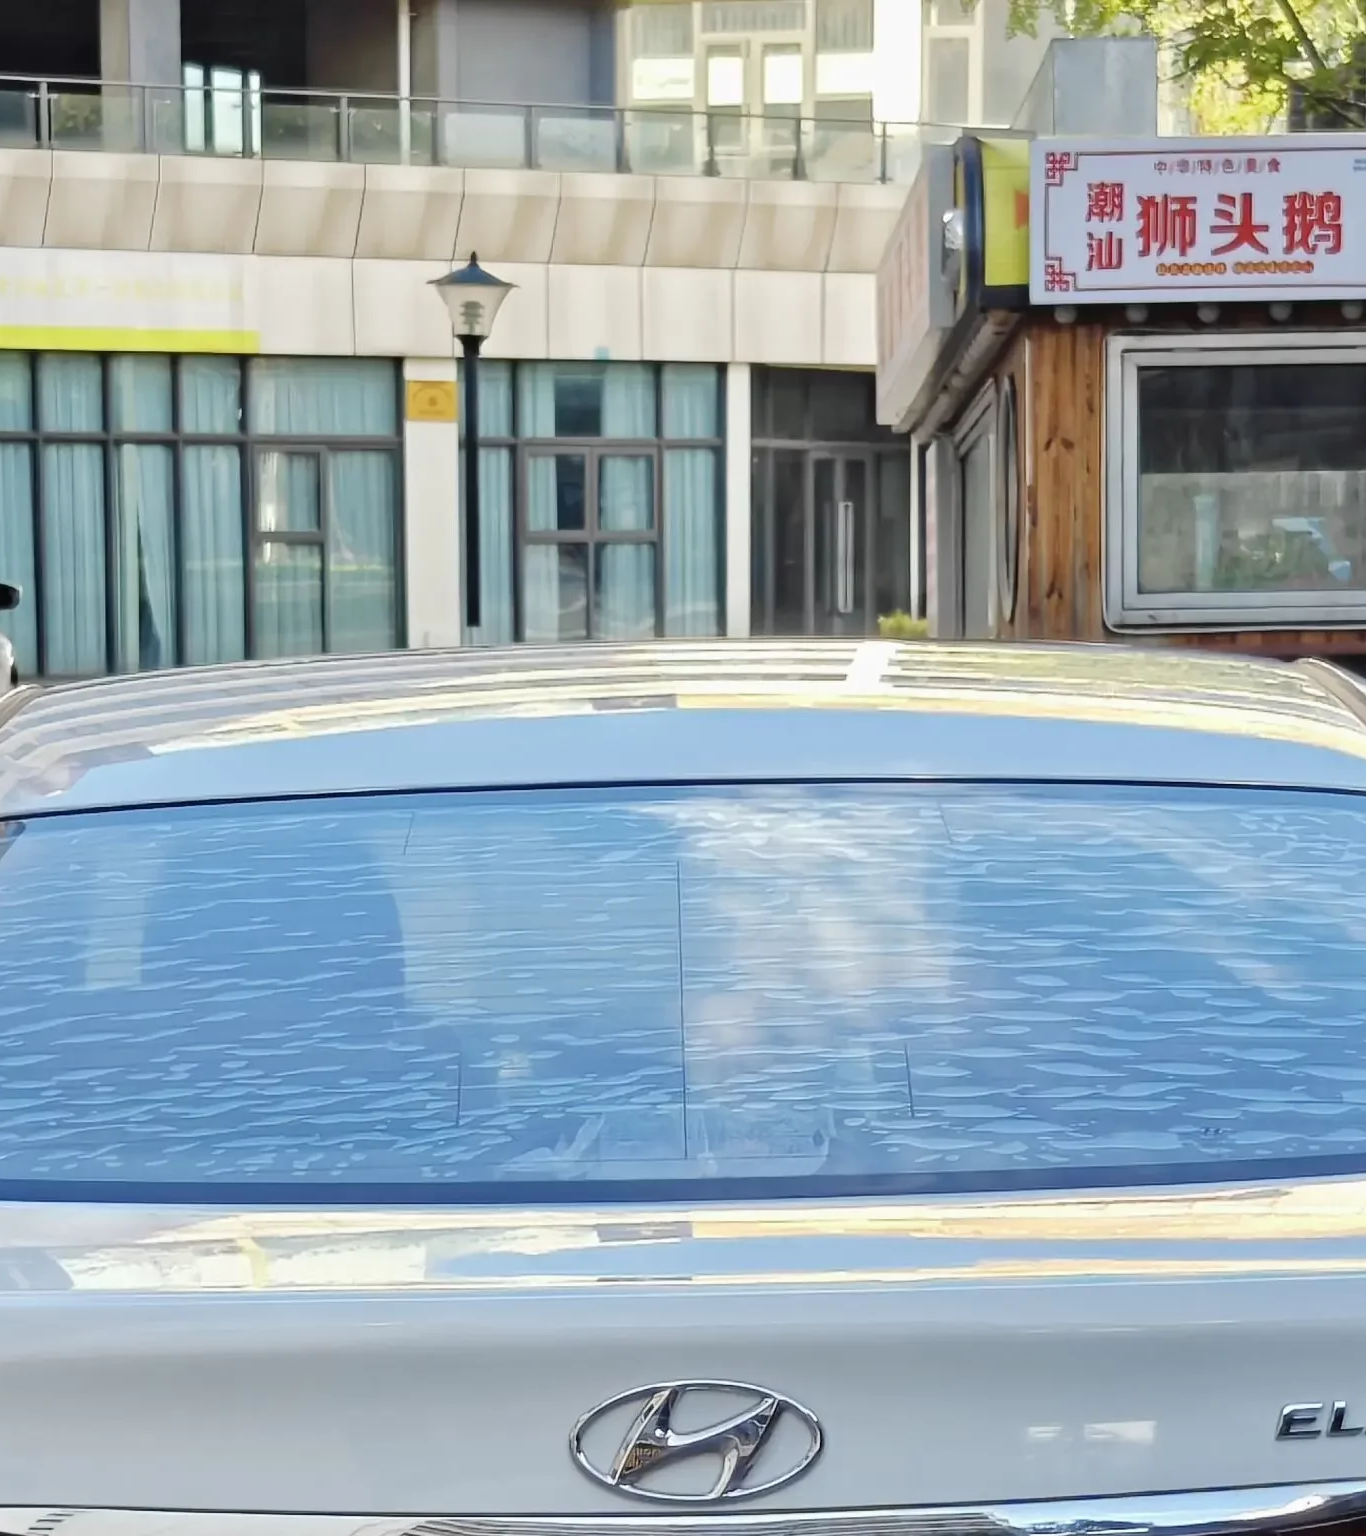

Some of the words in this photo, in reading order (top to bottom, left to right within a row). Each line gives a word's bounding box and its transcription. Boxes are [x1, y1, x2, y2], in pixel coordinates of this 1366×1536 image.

[1085, 181, 1125, 272] 潮汕
[1135, 191, 1344, 257] 狮头鹅
